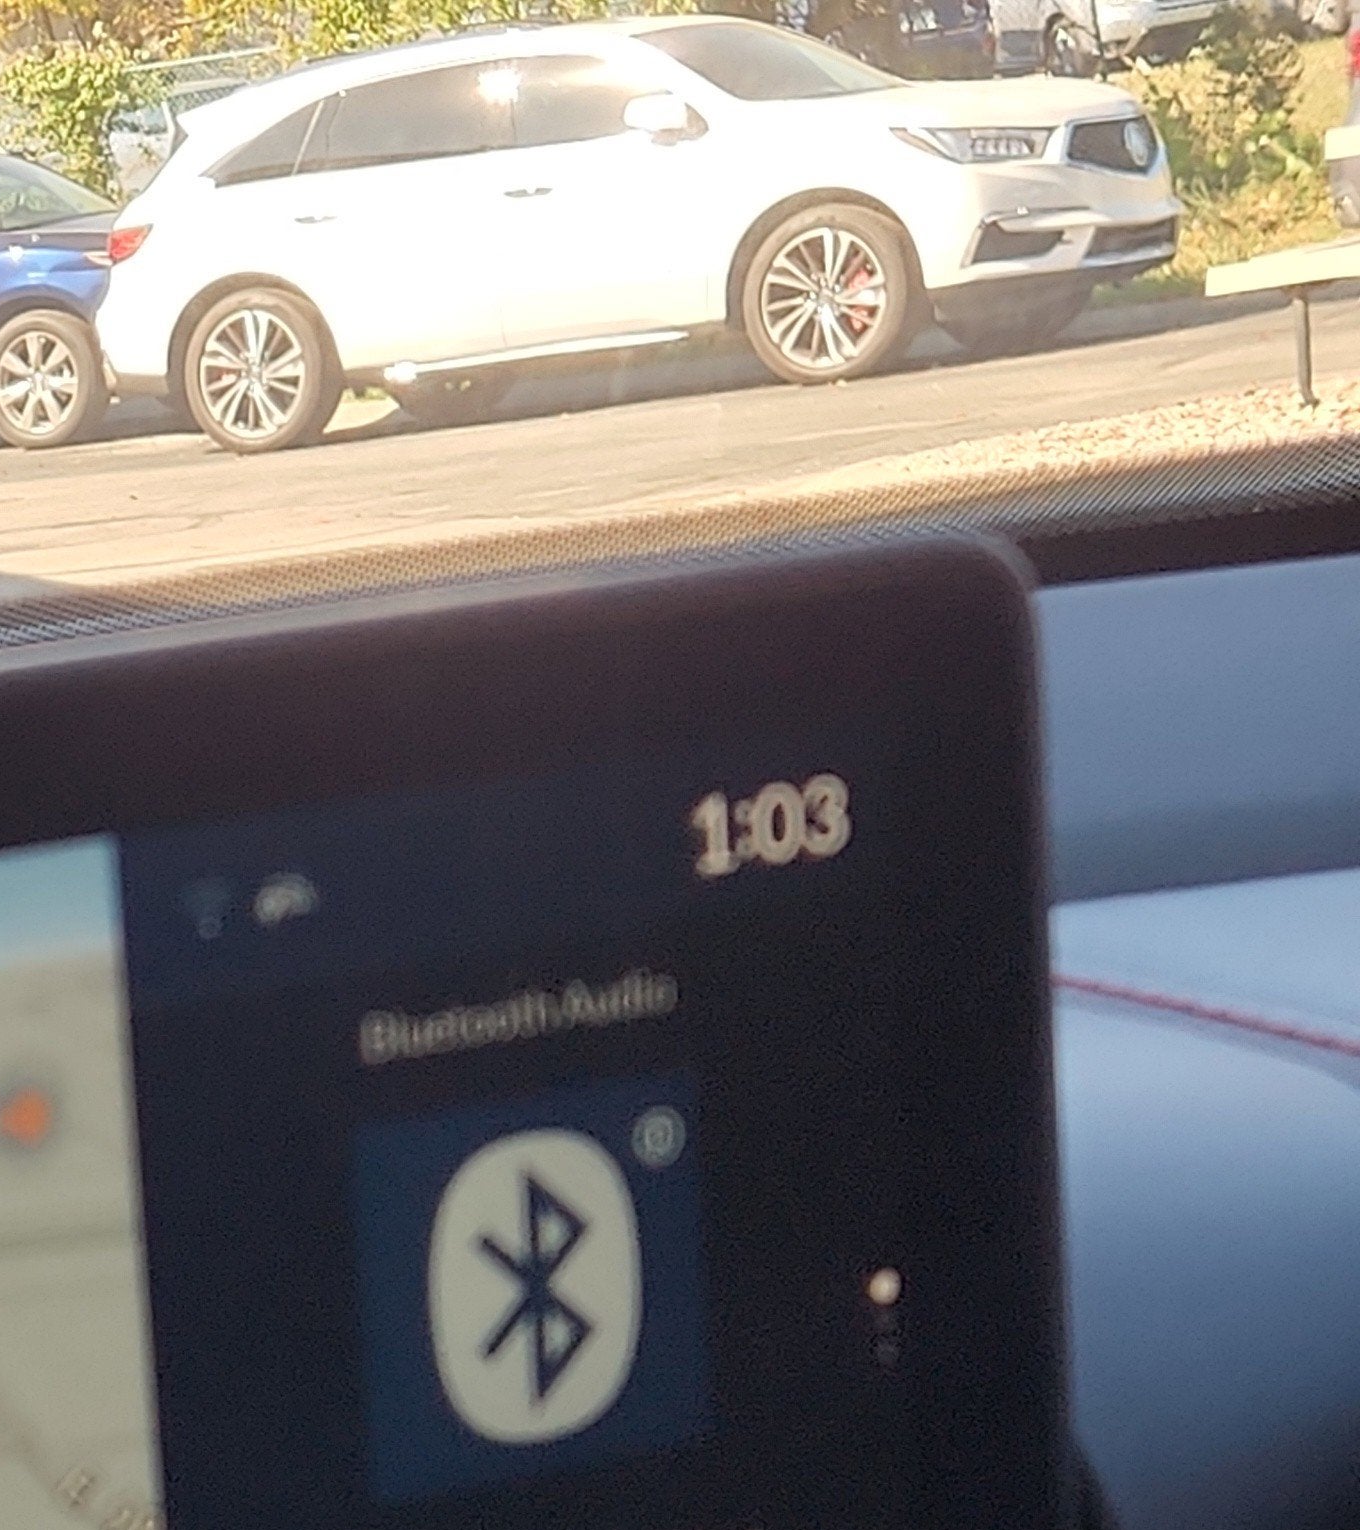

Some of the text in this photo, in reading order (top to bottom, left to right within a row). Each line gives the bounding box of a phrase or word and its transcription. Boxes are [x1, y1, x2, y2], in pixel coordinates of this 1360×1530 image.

[691, 772, 852, 879] 1:03
[361, 967, 679, 1064] Bluetooth Audio
